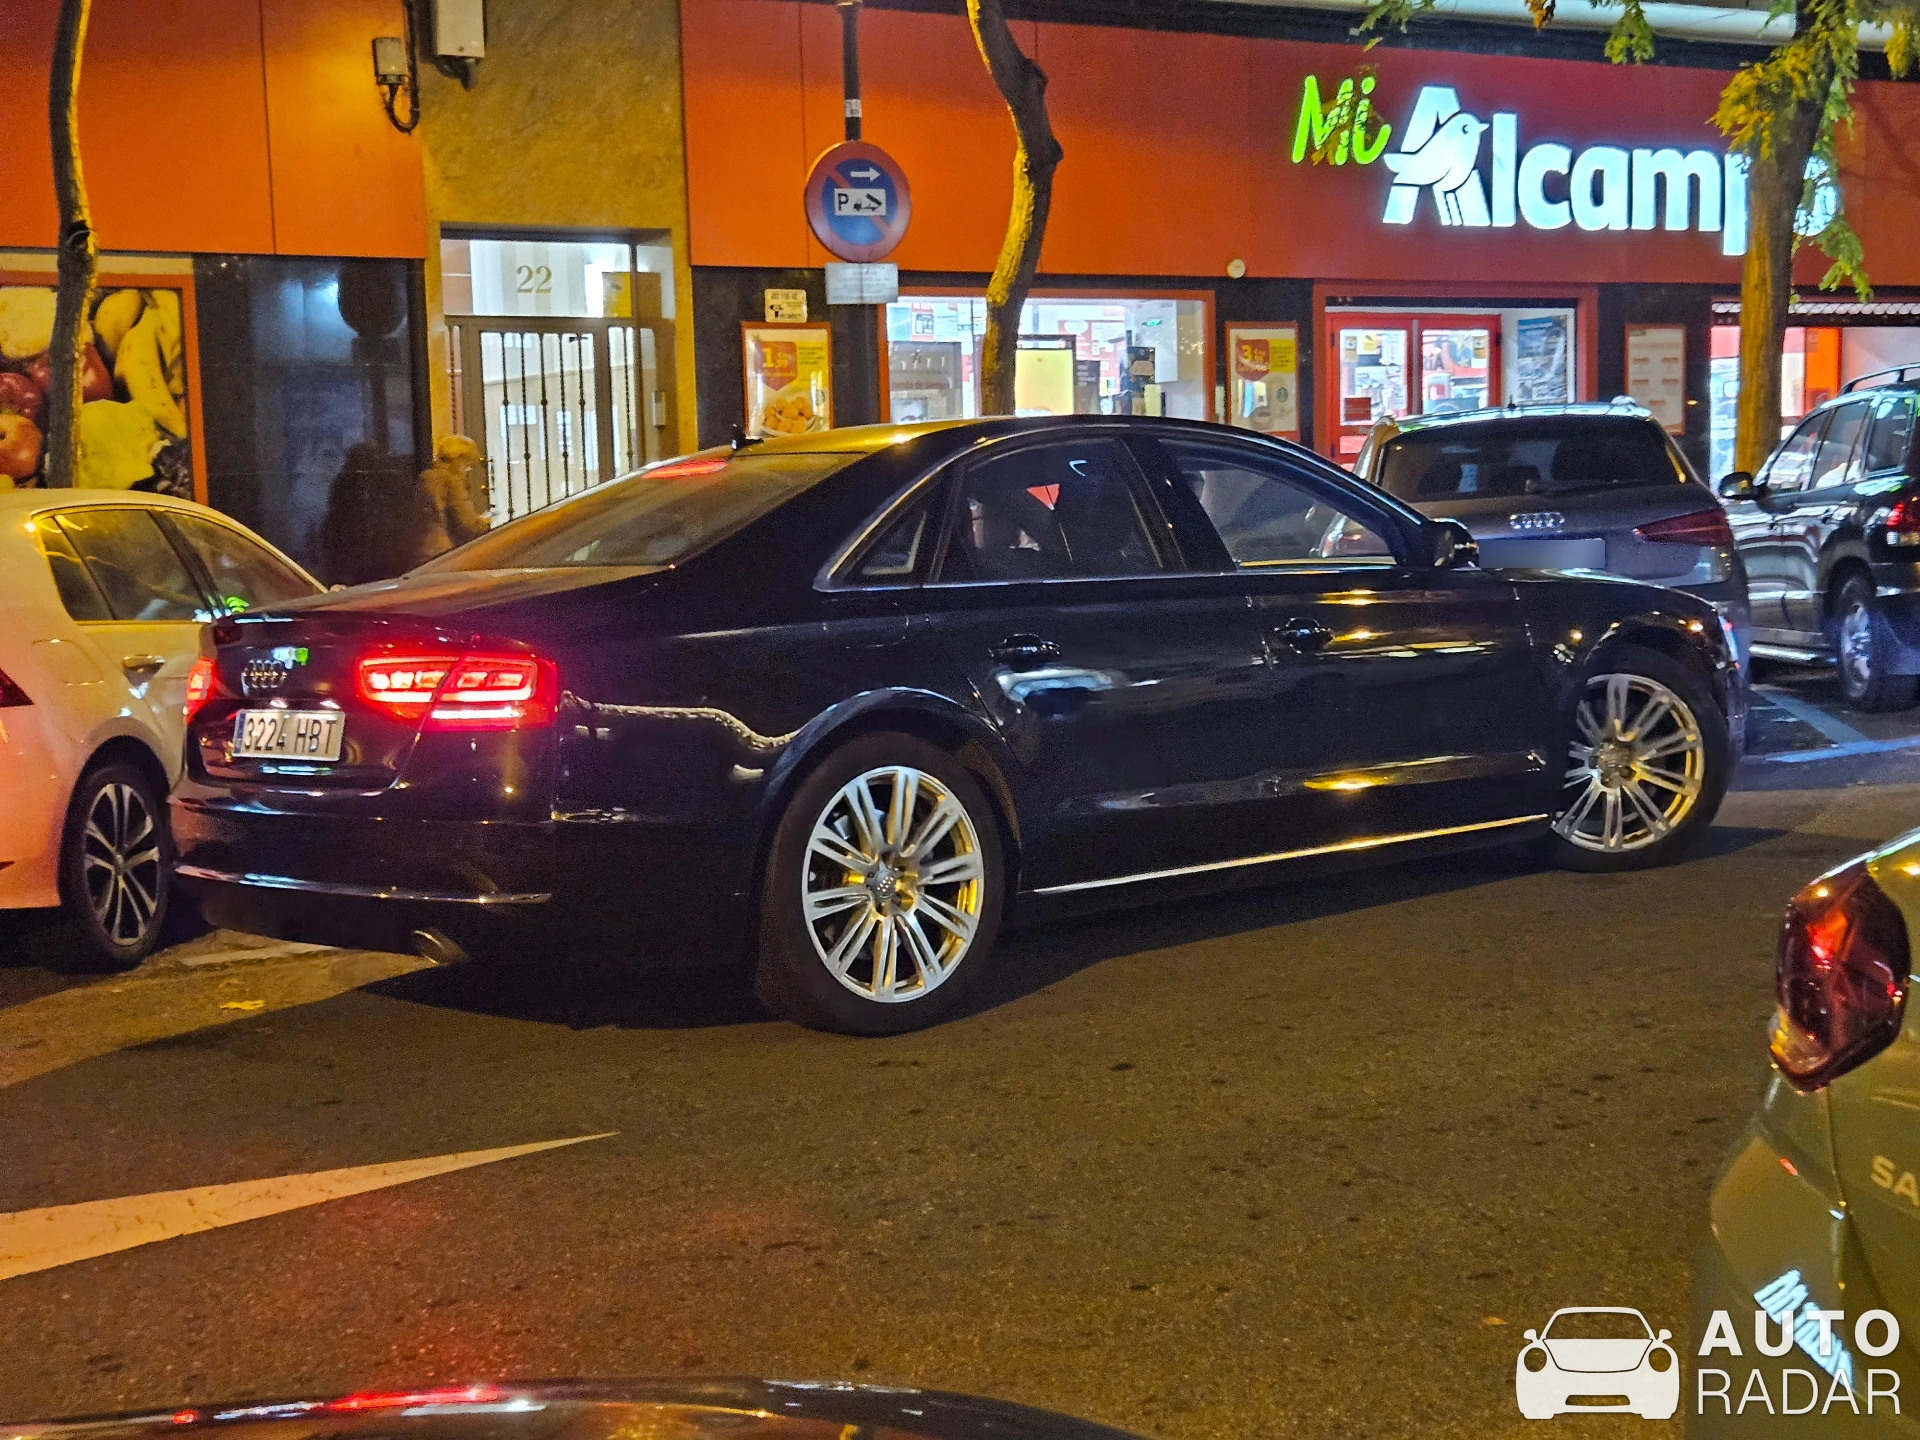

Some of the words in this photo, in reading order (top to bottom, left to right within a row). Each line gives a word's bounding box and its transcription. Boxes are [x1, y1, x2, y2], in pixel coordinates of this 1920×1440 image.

[1292, 75, 1391, 164] Mi
[838, 193, 849, 211] P
[516, 265, 552, 294] 22
[244, 717, 286, 752] 3224
[294, 718, 337, 755] HBT
[1870, 1155, 1920, 1208] SA
